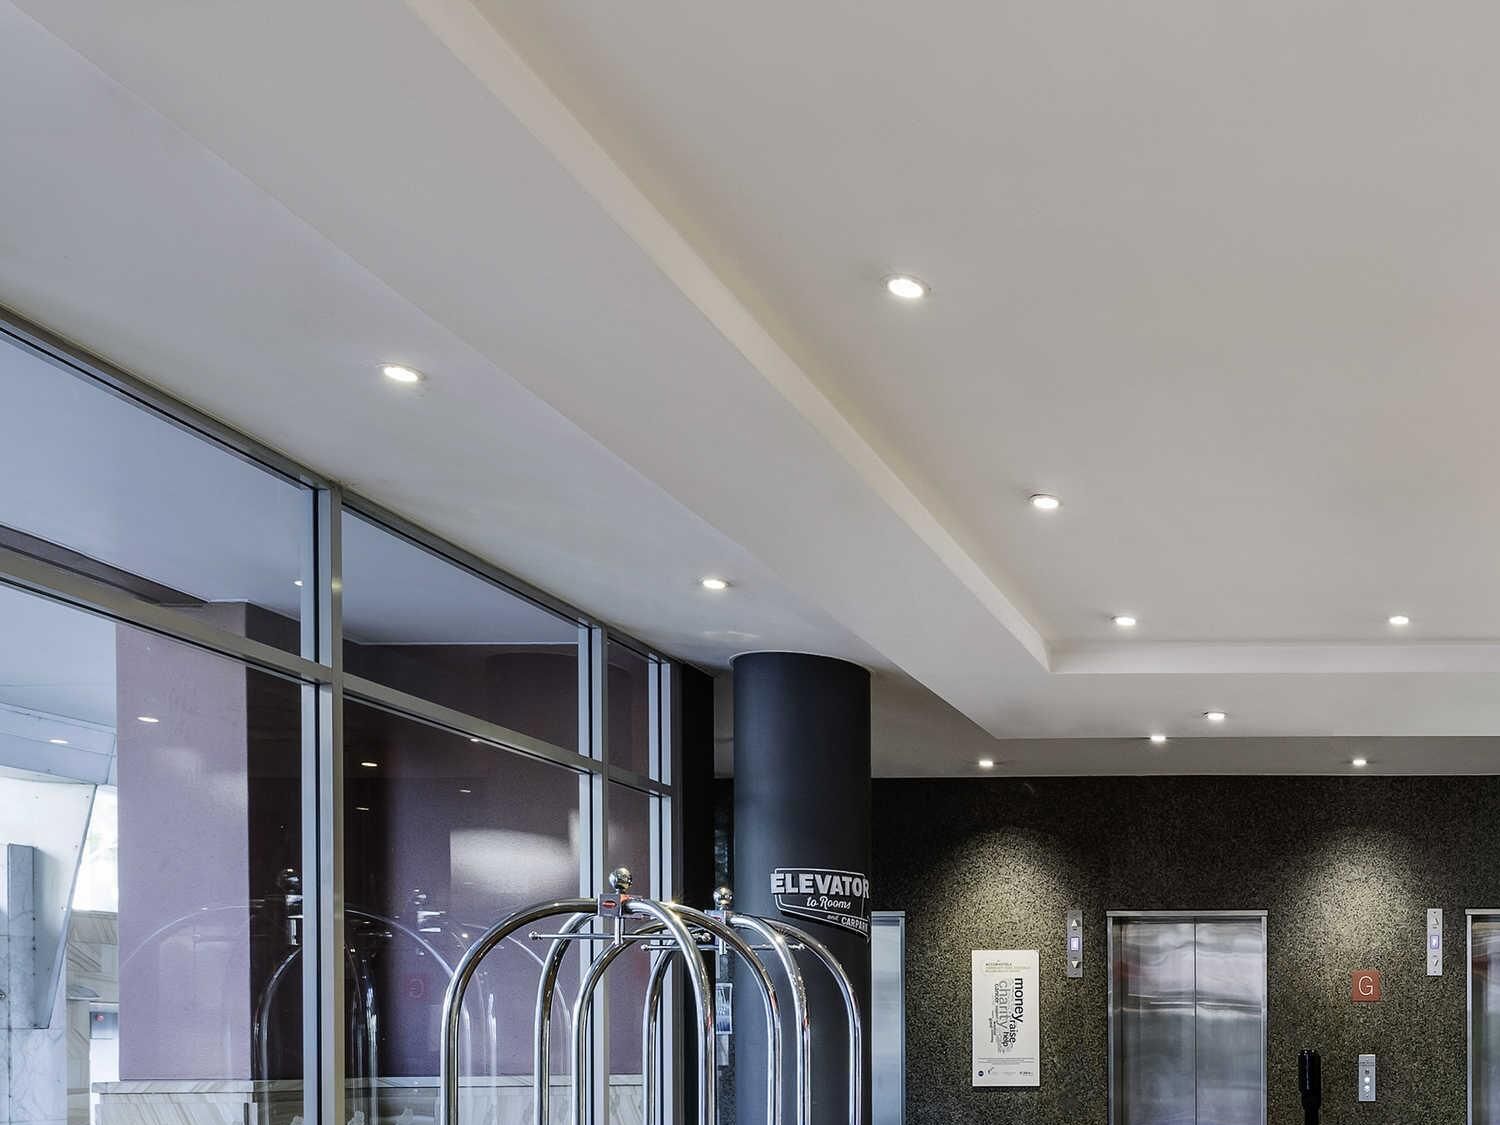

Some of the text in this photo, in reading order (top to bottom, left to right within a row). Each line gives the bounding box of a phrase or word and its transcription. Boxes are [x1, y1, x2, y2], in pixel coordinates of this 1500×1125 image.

[770, 873, 870, 899] ELEVATOR
[806, 895, 852, 910] to Rooms
[1359, 975, 1374, 996] G
[997, 980, 1011, 1029] charity
[1011, 977, 1024, 1023] money
[1001, 1031, 1010, 1047] help
[1009, 1019, 1018, 1043] raise
